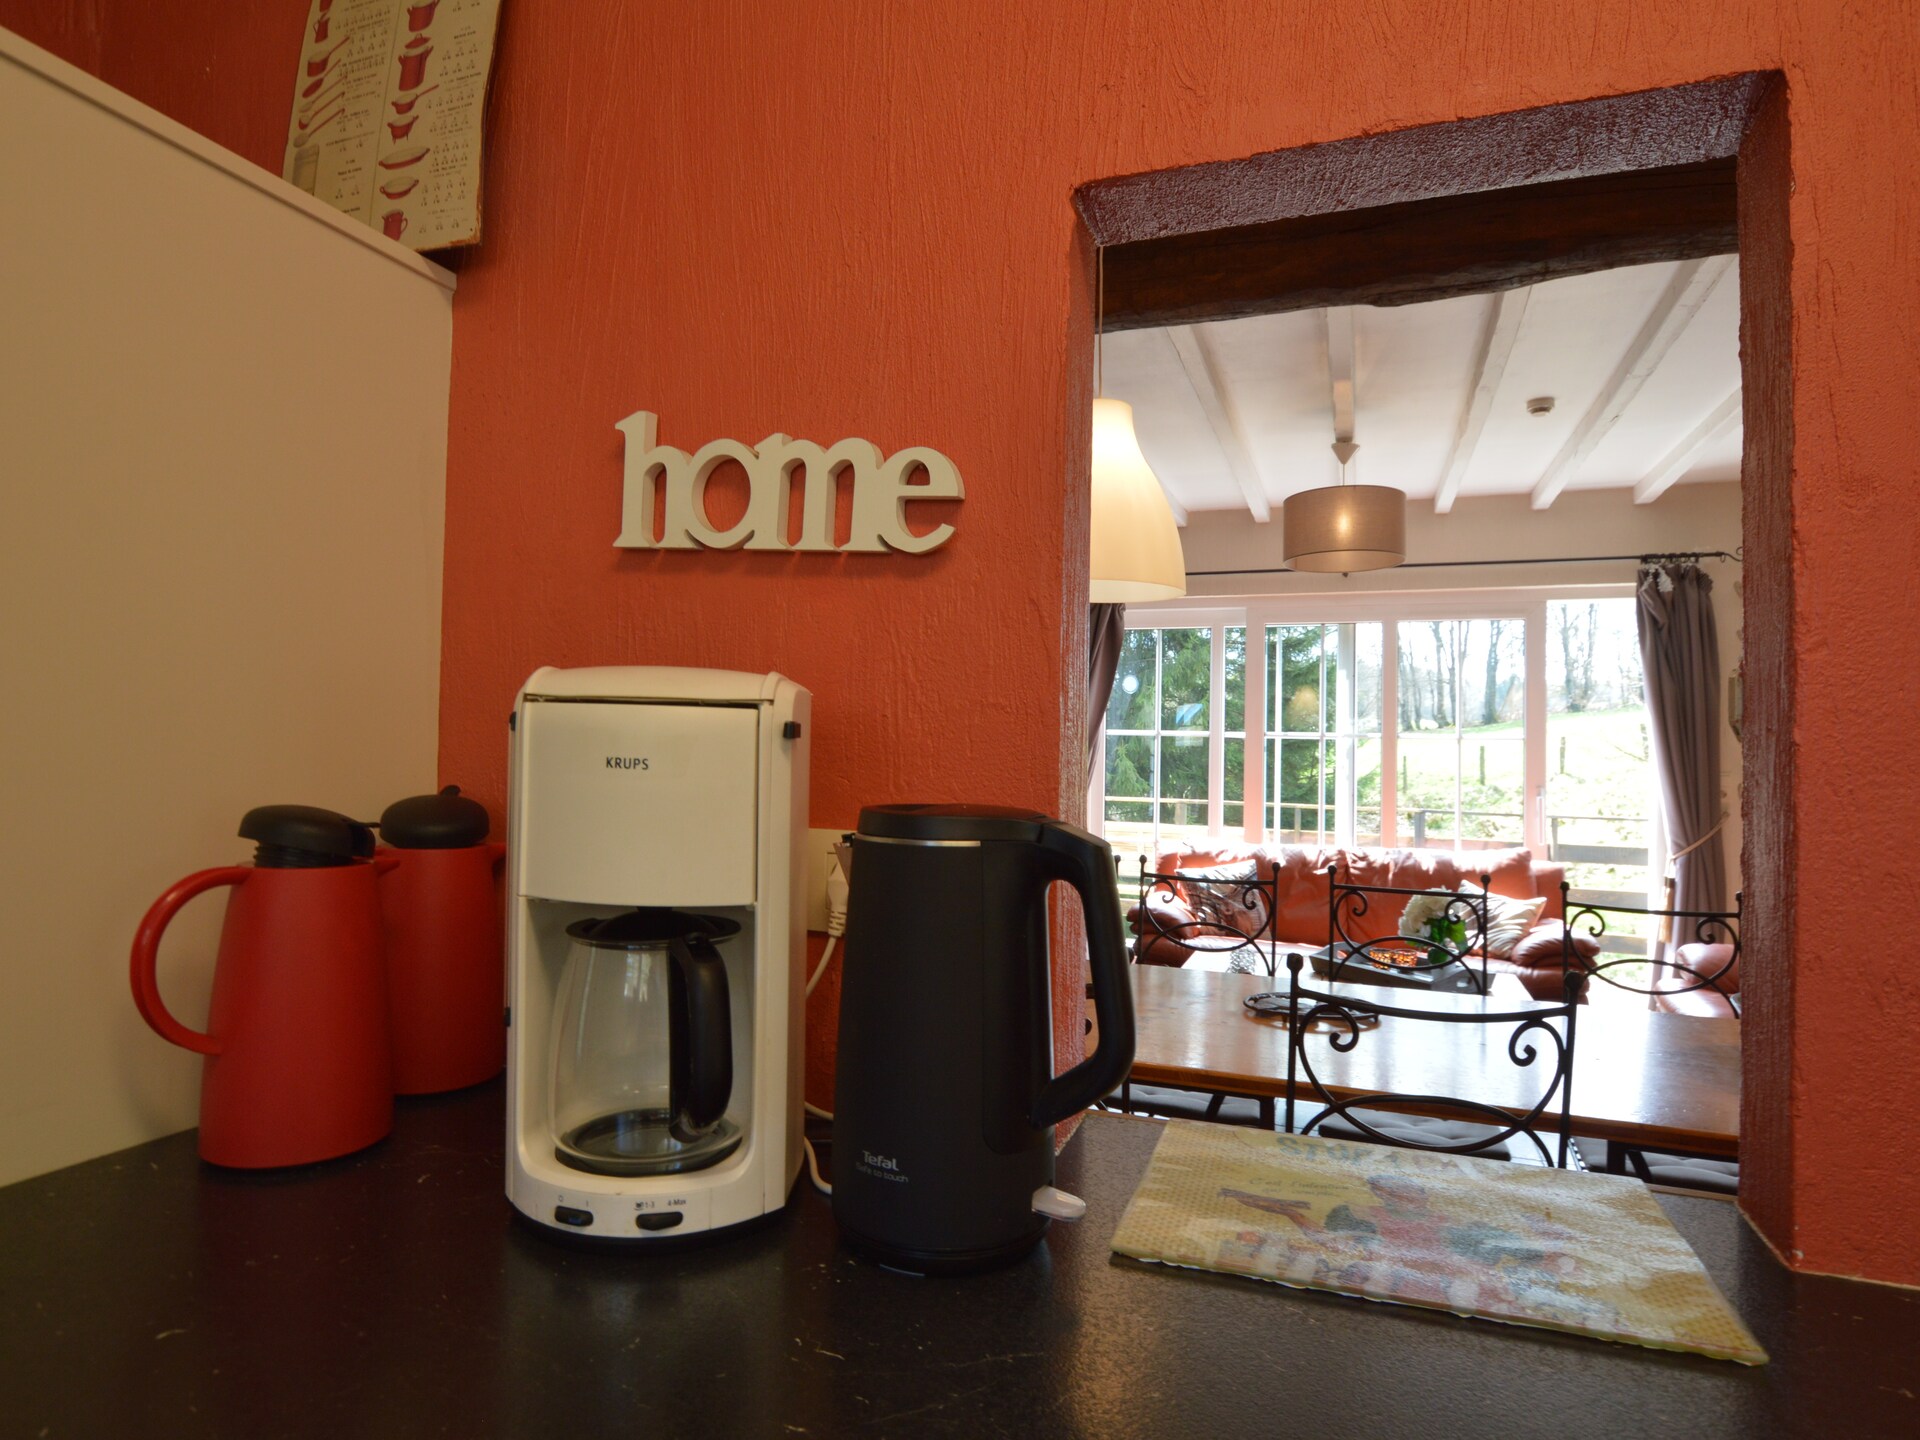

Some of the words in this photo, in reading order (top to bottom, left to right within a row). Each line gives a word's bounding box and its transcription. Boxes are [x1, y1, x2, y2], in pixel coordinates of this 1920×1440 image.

[611, 410, 965, 554] home
[606, 756, 649, 771] KRUPS
[862, 1149, 899, 1171] Tefal
